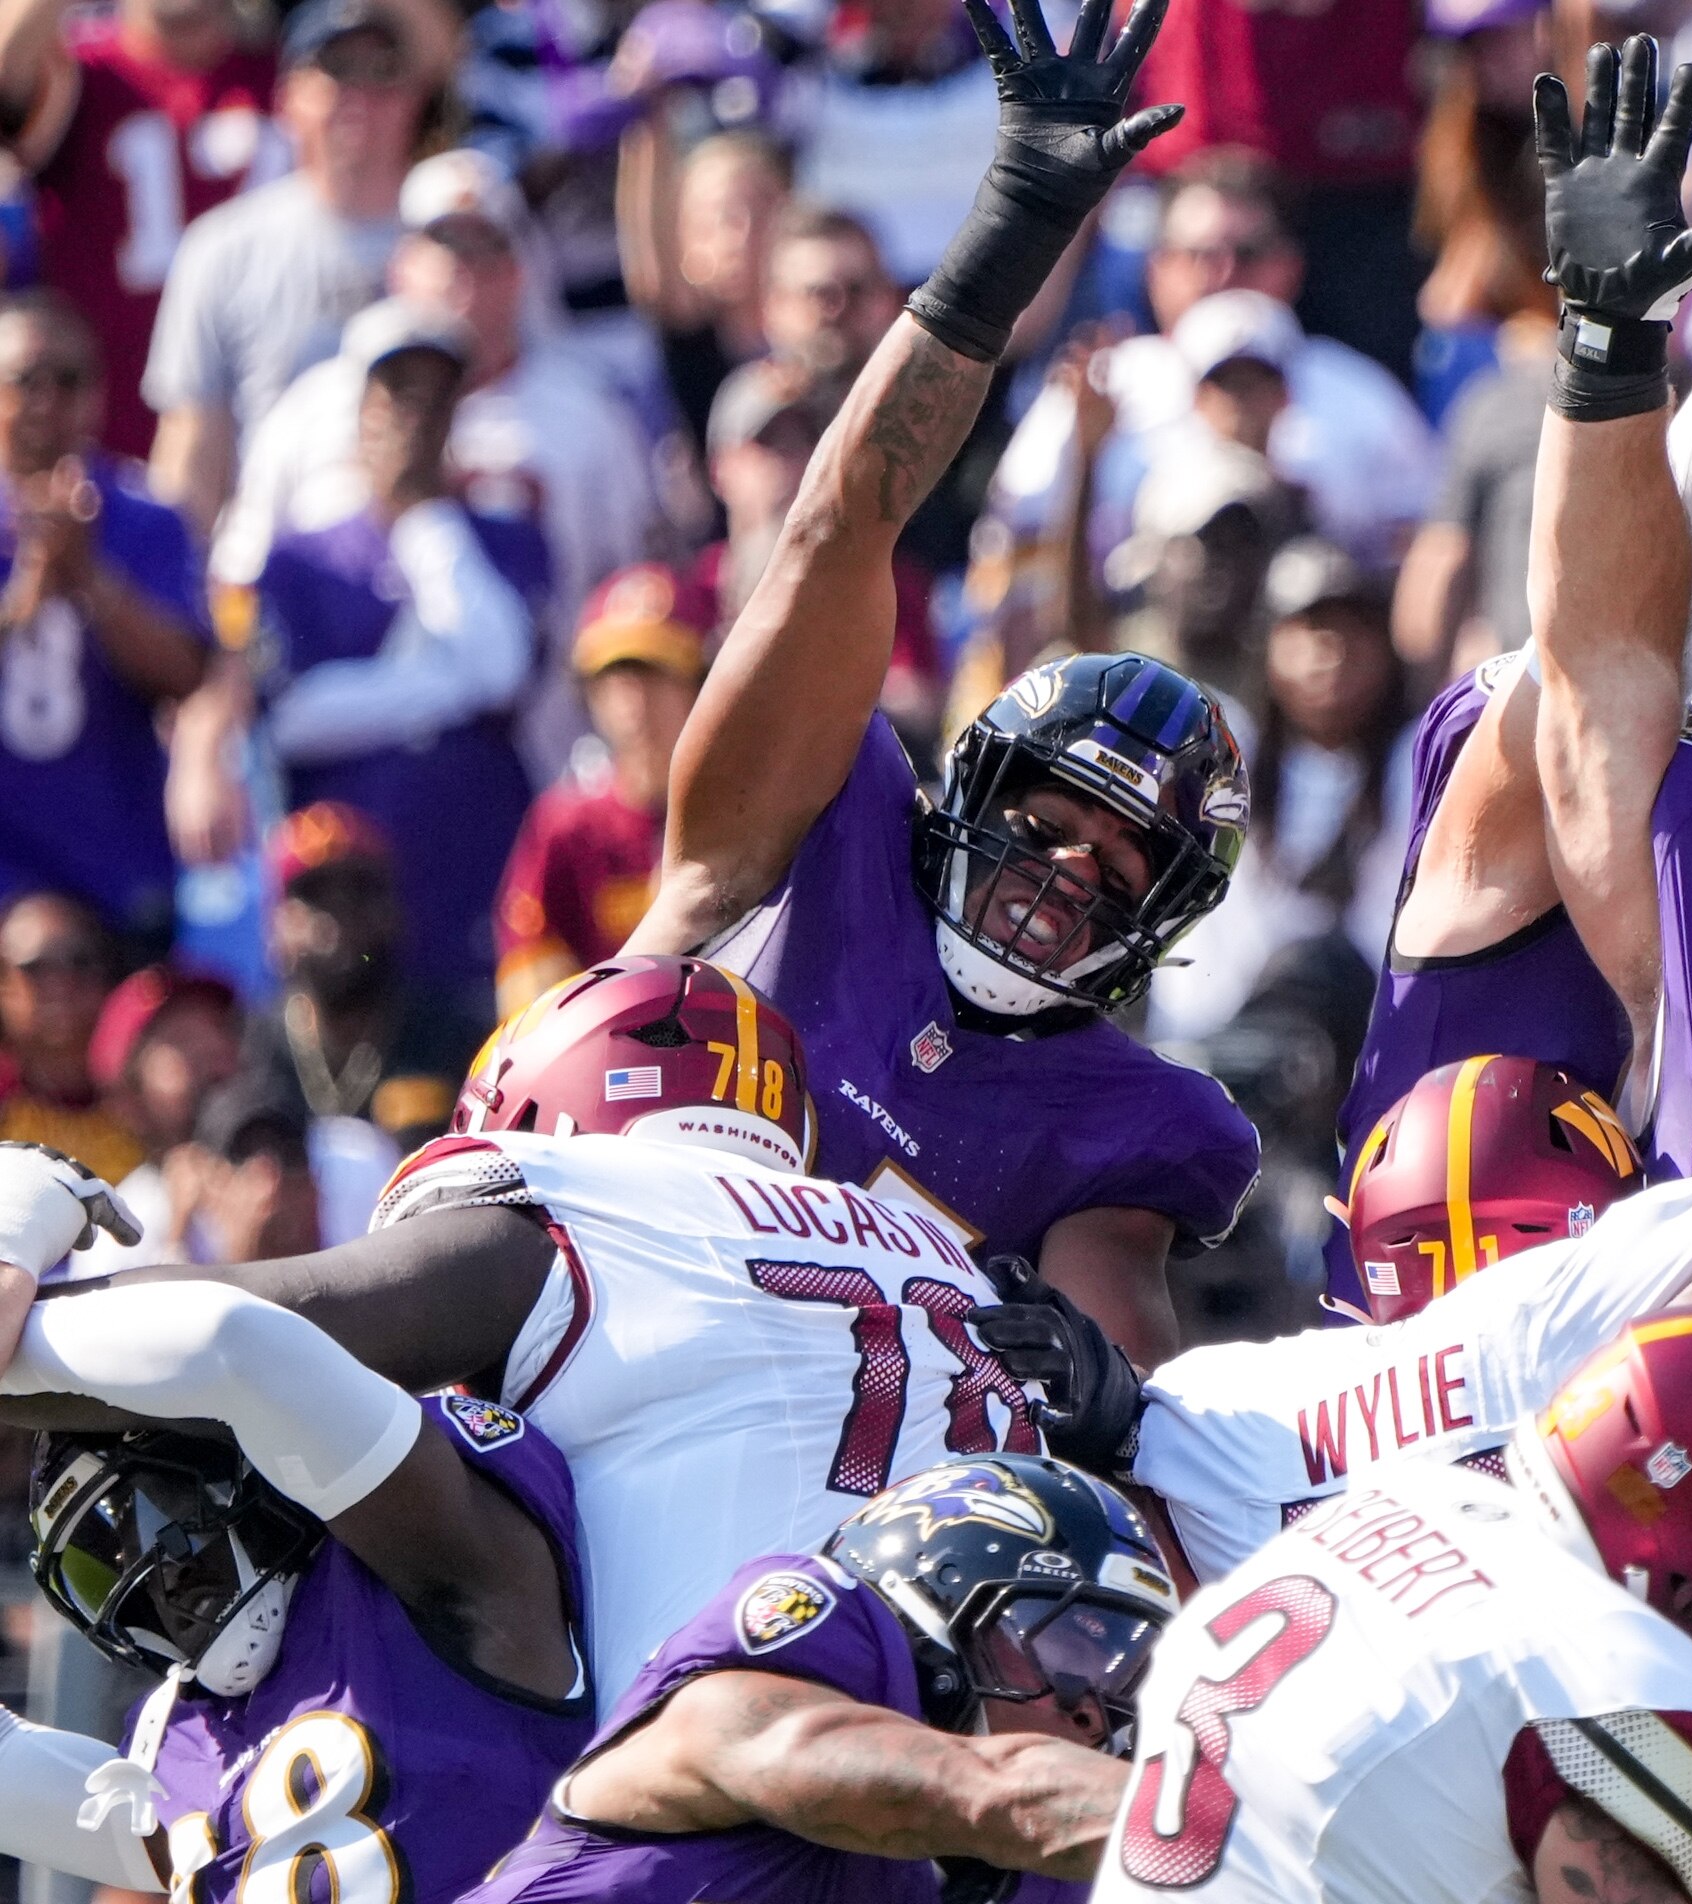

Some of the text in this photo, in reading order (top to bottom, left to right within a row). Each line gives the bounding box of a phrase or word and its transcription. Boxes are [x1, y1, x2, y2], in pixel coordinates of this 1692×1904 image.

[1578, 347, 1601, 361] 4XL
[1095, 749, 1145, 787] RAVENS
[916, 1037, 937, 1067] NFL
[838, 1078, 921, 1158] RAVENS
[678, 1121, 798, 1168] WASHINGTON
[714, 1175, 921, 1258] LUCAS
[1298, 1343, 1474, 1487] WYLIE
[1022, 1563, 1082, 1580] OAKLEY
[1119, 1573, 1339, 1893] 3
